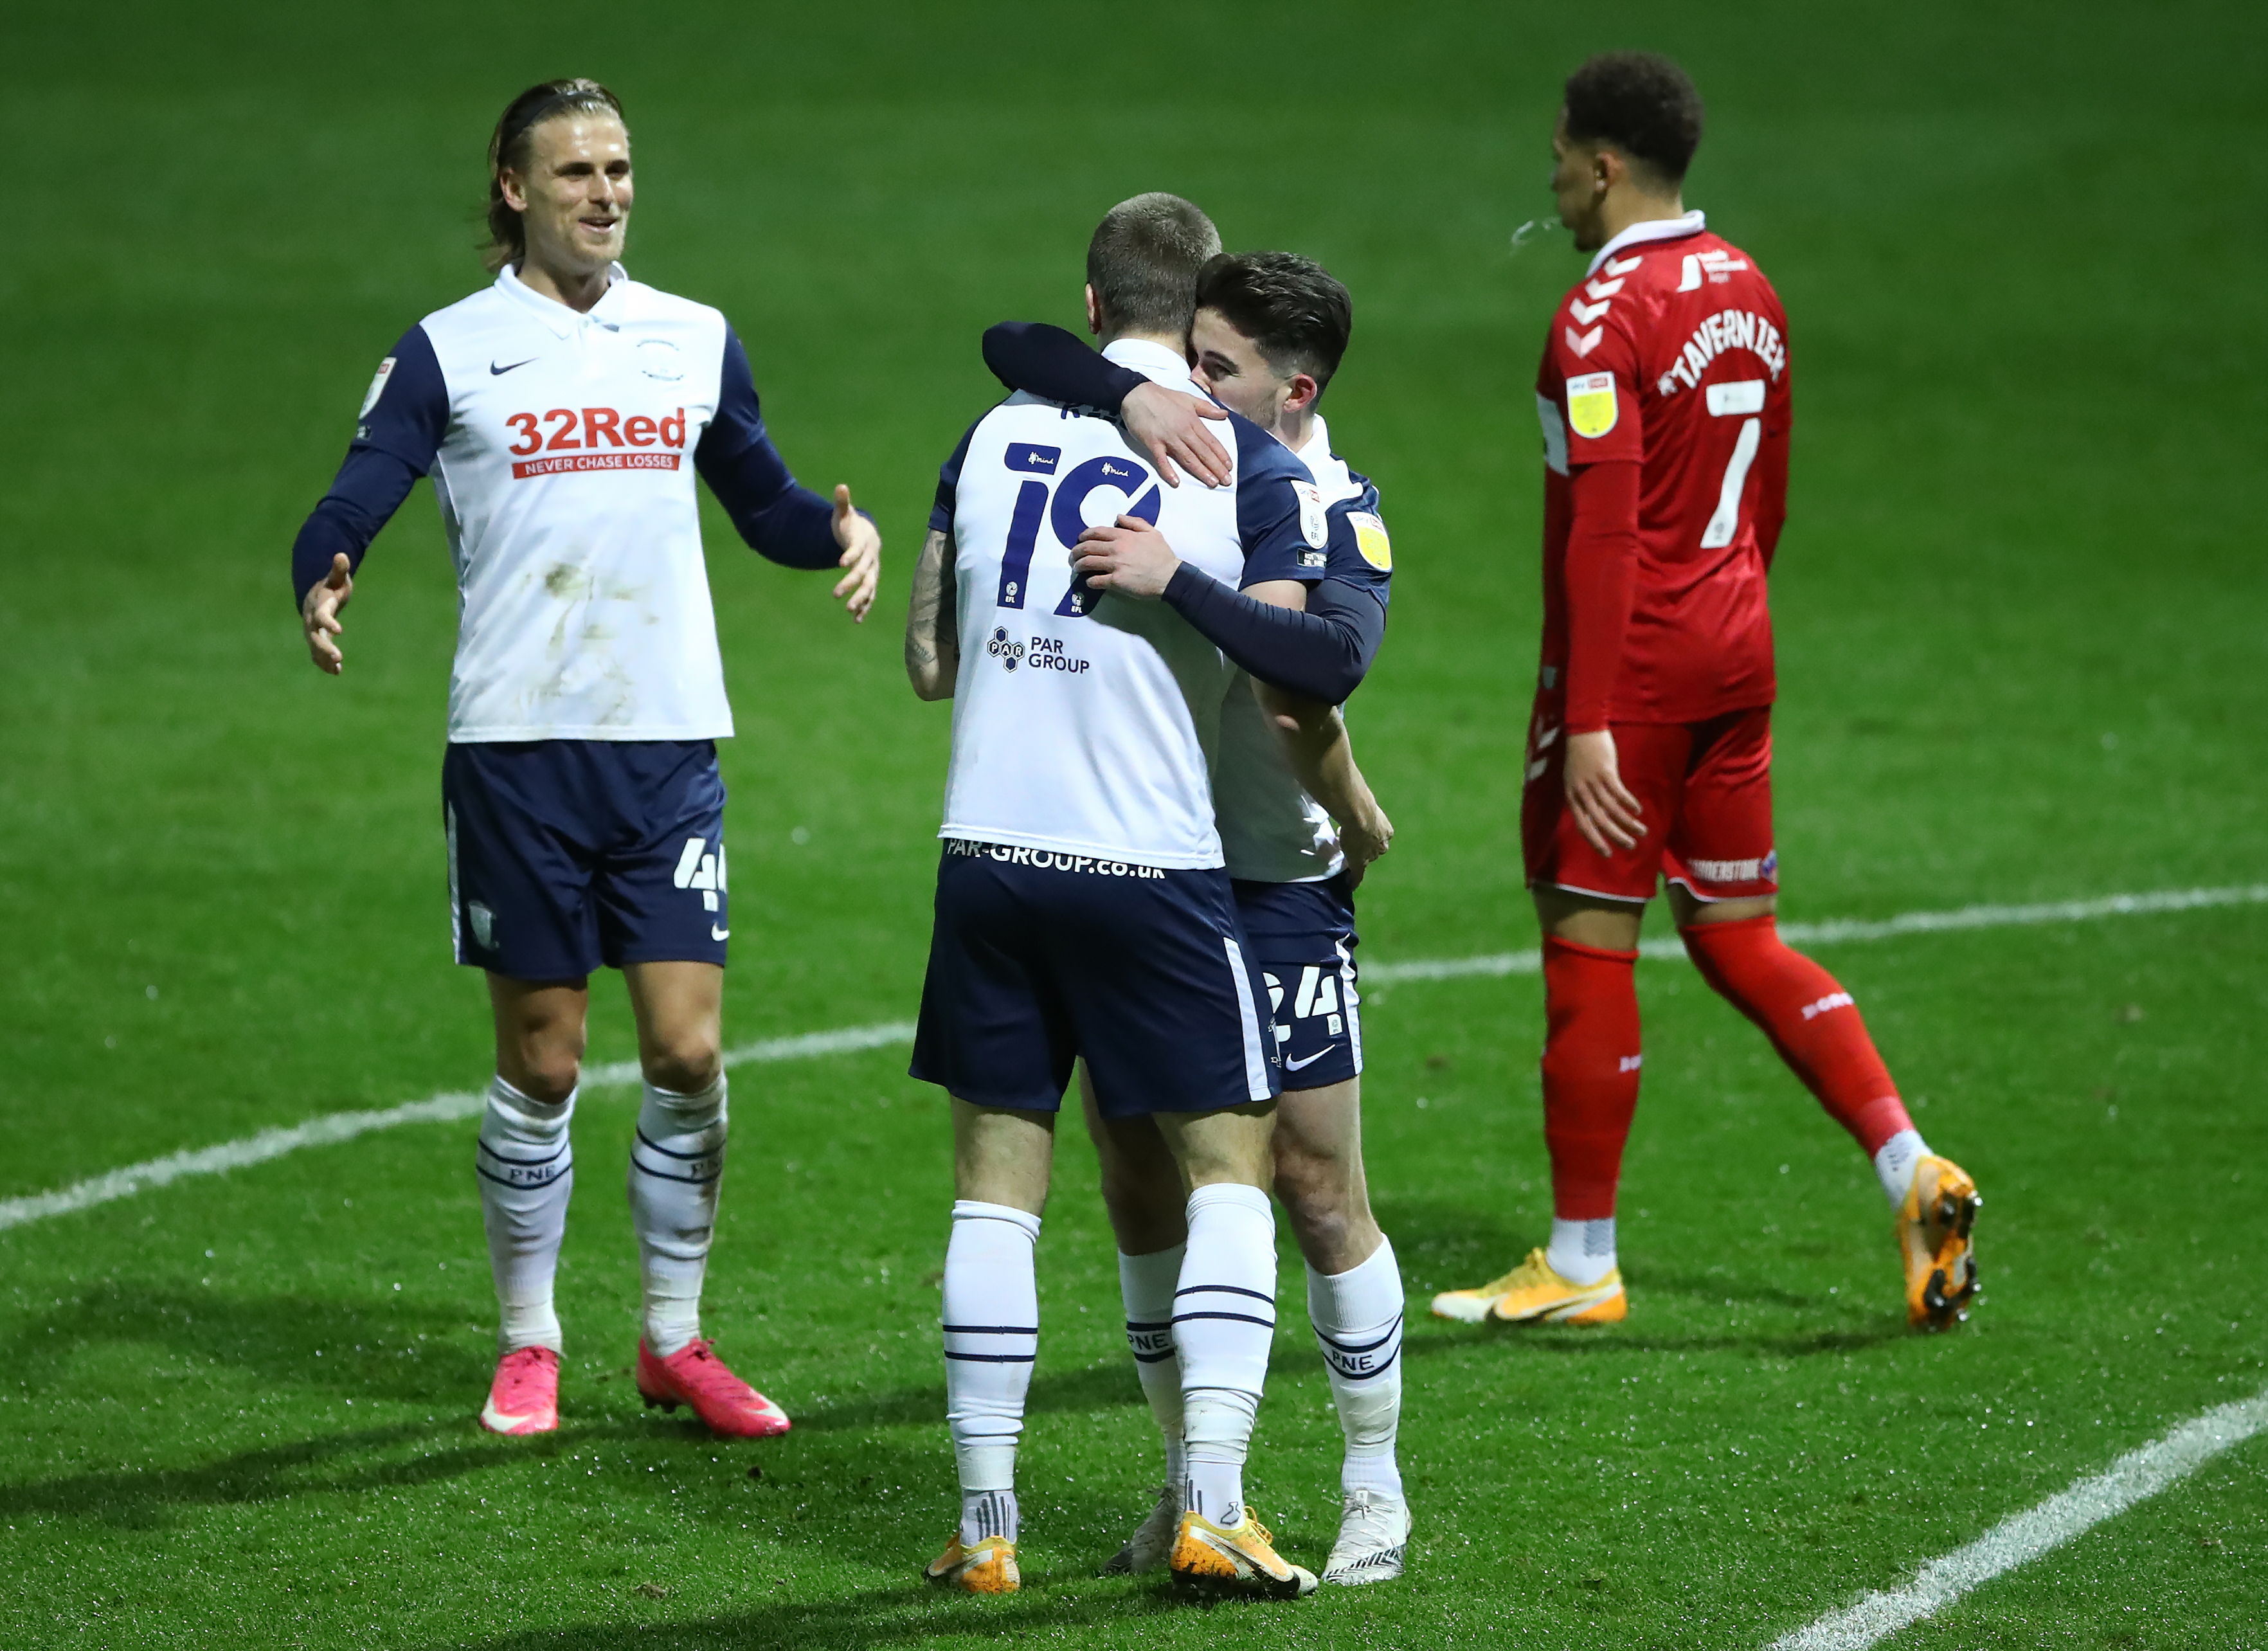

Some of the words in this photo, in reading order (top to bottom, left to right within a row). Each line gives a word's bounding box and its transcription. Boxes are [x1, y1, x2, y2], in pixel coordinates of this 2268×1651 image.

[506, 407, 685, 456] 32Red
[525, 458, 573, 474] NEVER
[577, 455, 623, 470] CHASE
[626, 455, 673, 469] LOSSES
[1700, 379, 1765, 549] 7
[997, 442, 1161, 617] 19
[1030, 636, 1063, 654] PAR
[1029, 653, 1090, 674] GROUP
[673, 837, 728, 912] 4
[1332, 1351, 1375, 1371] PNE
